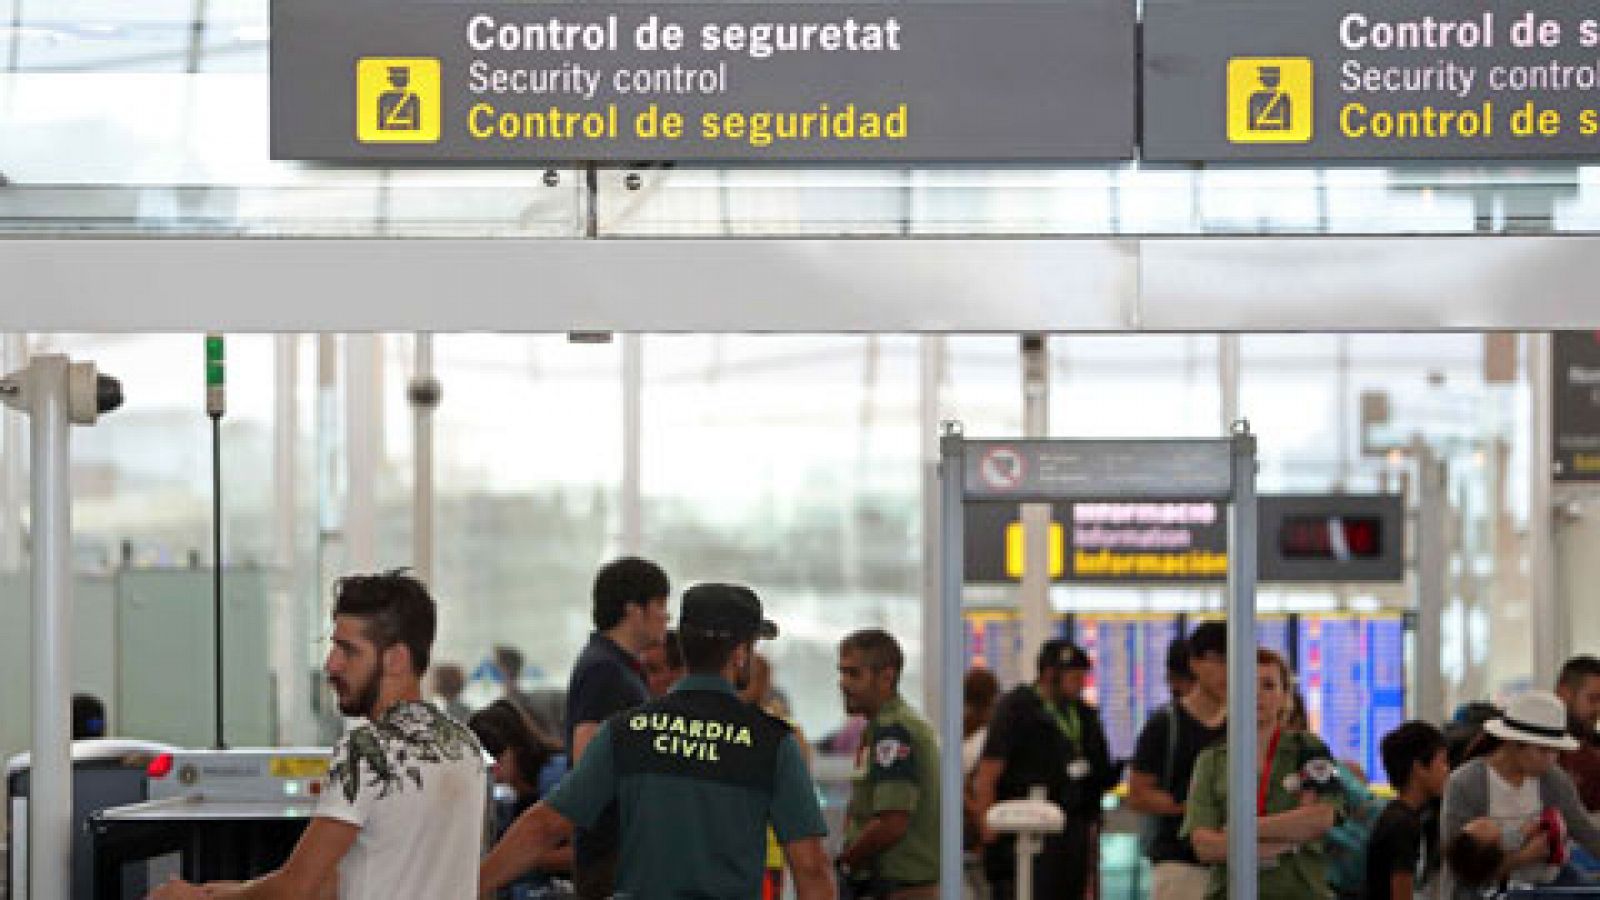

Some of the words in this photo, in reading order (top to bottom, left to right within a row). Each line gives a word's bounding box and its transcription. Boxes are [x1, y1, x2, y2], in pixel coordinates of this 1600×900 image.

[466, 14, 618, 51] Control
[635, 15, 684, 51] de
[700, 17, 902, 58] seguretat
[1339, 11, 1494, 50] Control
[1509, 11, 1561, 48] de
[469, 60, 601, 99] Security
[612, 61, 727, 95] control
[1340, 59, 1477, 98] Security
[467, 103, 618, 139] Control
[635, 103, 684, 139] de
[701, 103, 908, 147] seguridad
[1339, 101, 1492, 138] Control
[1509, 100, 1561, 137] de
[629, 712, 753, 747] GUARDIA
[653, 733, 720, 762] CIVIL
